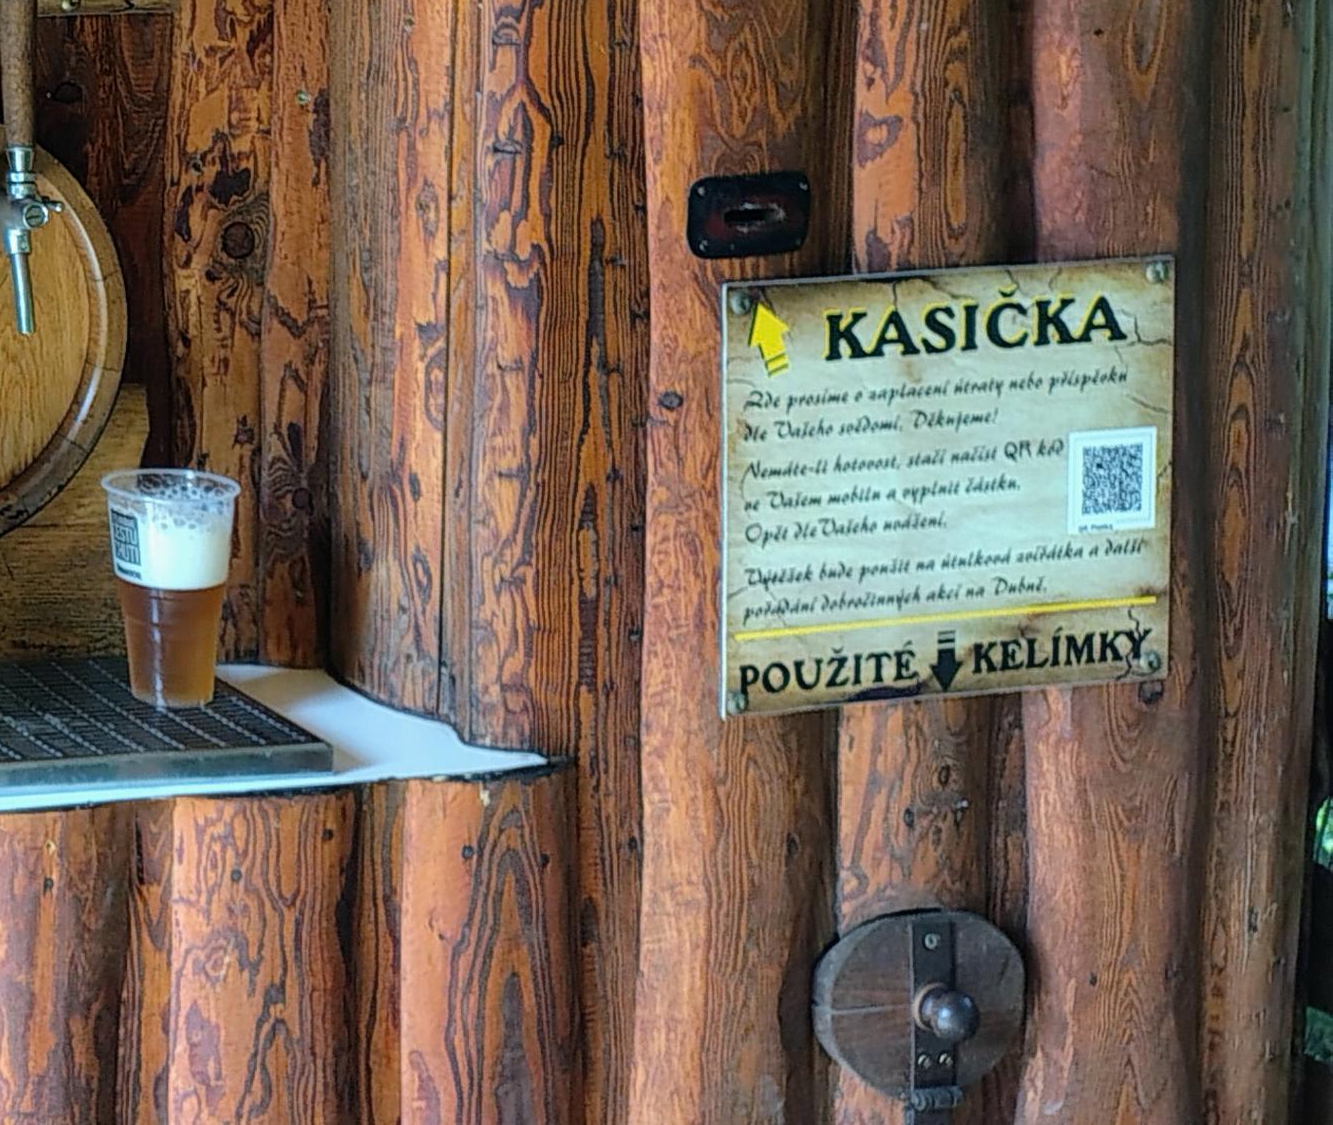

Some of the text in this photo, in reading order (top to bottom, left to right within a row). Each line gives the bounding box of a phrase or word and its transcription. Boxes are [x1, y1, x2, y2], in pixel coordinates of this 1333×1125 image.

[823, 285, 1129, 362] KASIČKA
[1004, 440, 1032, 463] QR
[739, 625, 1152, 698] POUŽITÉ KELÍMKY
